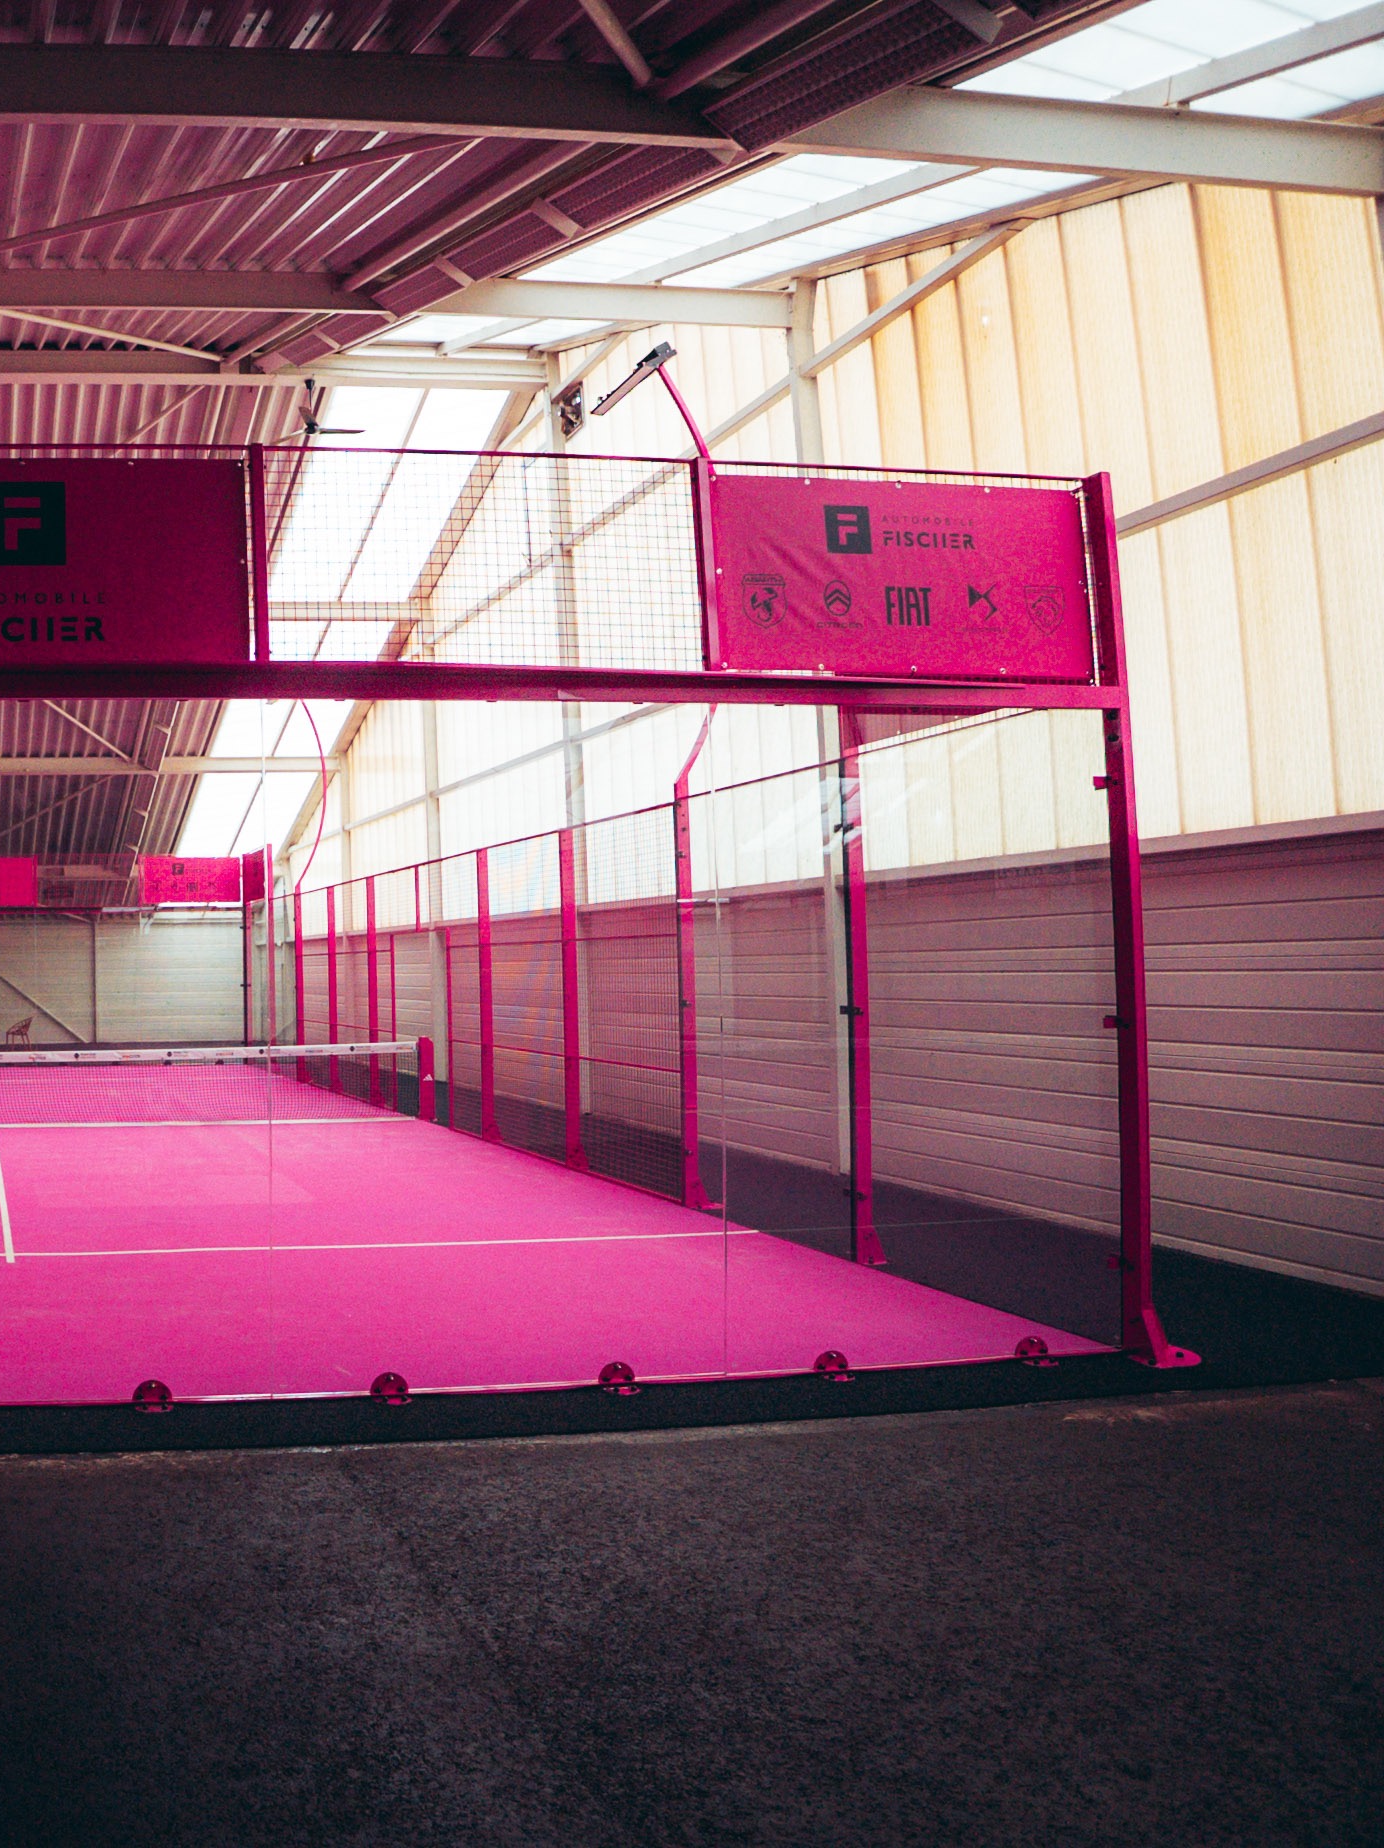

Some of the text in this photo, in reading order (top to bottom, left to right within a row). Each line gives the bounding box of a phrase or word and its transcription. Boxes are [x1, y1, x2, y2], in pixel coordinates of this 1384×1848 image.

[880, 514, 976, 528] AUTOMOBILE
[882, 530, 976, 550] FISCHER
[884, 586, 932, 627] FIAT
